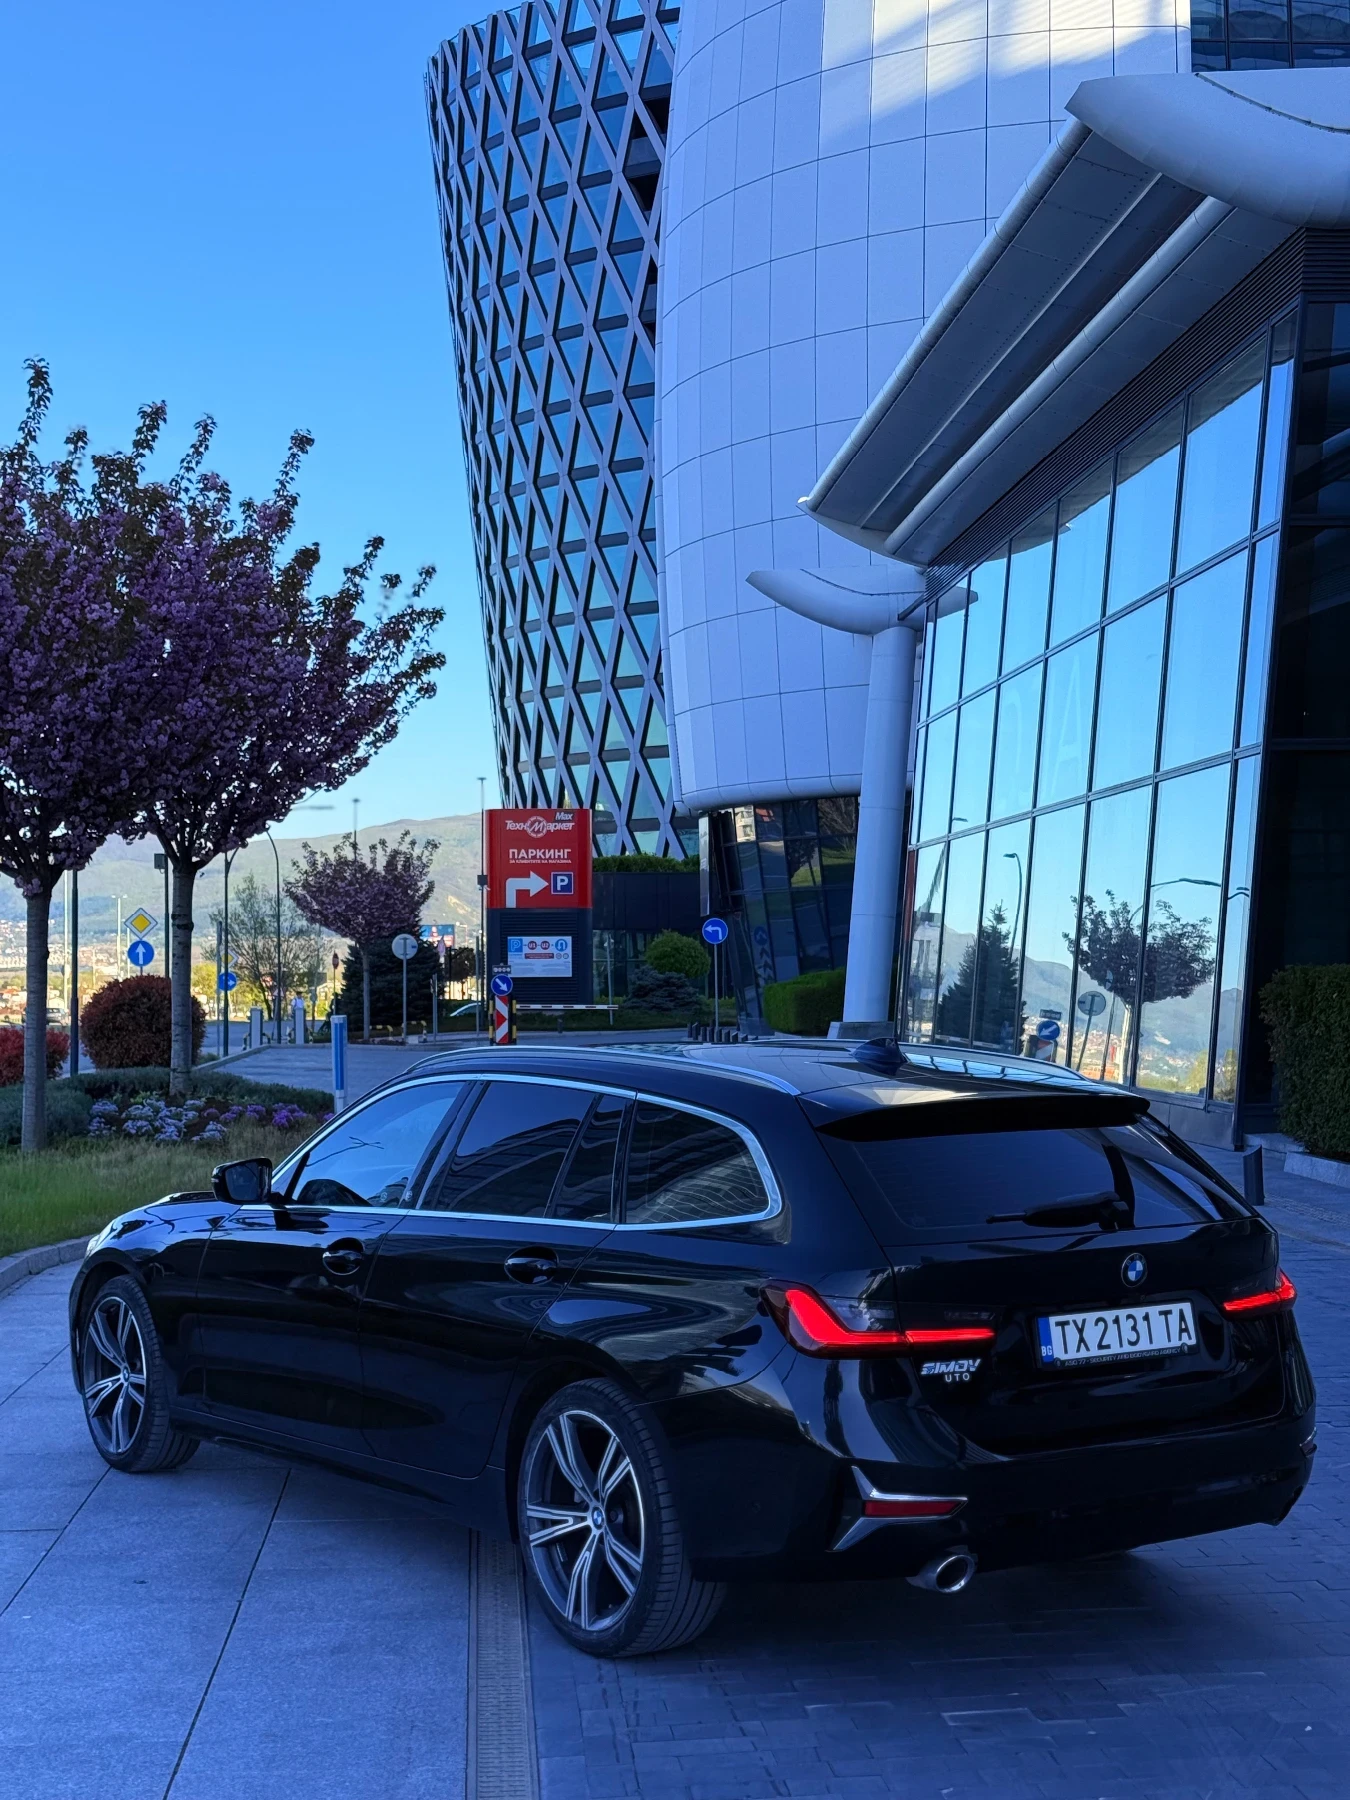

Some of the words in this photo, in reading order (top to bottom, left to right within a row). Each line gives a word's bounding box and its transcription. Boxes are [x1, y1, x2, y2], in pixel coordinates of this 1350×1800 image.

[555, 812, 573, 820] Max
[509, 849, 571, 858] ПАРКИНГ
[557, 876, 568, 891] P
[1055, 1318, 1090, 1354] TX
[1094, 1312, 1153, 1350] 2131
[1158, 1308, 1192, 1343] TA
[1041, 1345, 1053, 1357] BG
[1089, 1355, 1117, 1364] SECURITY
